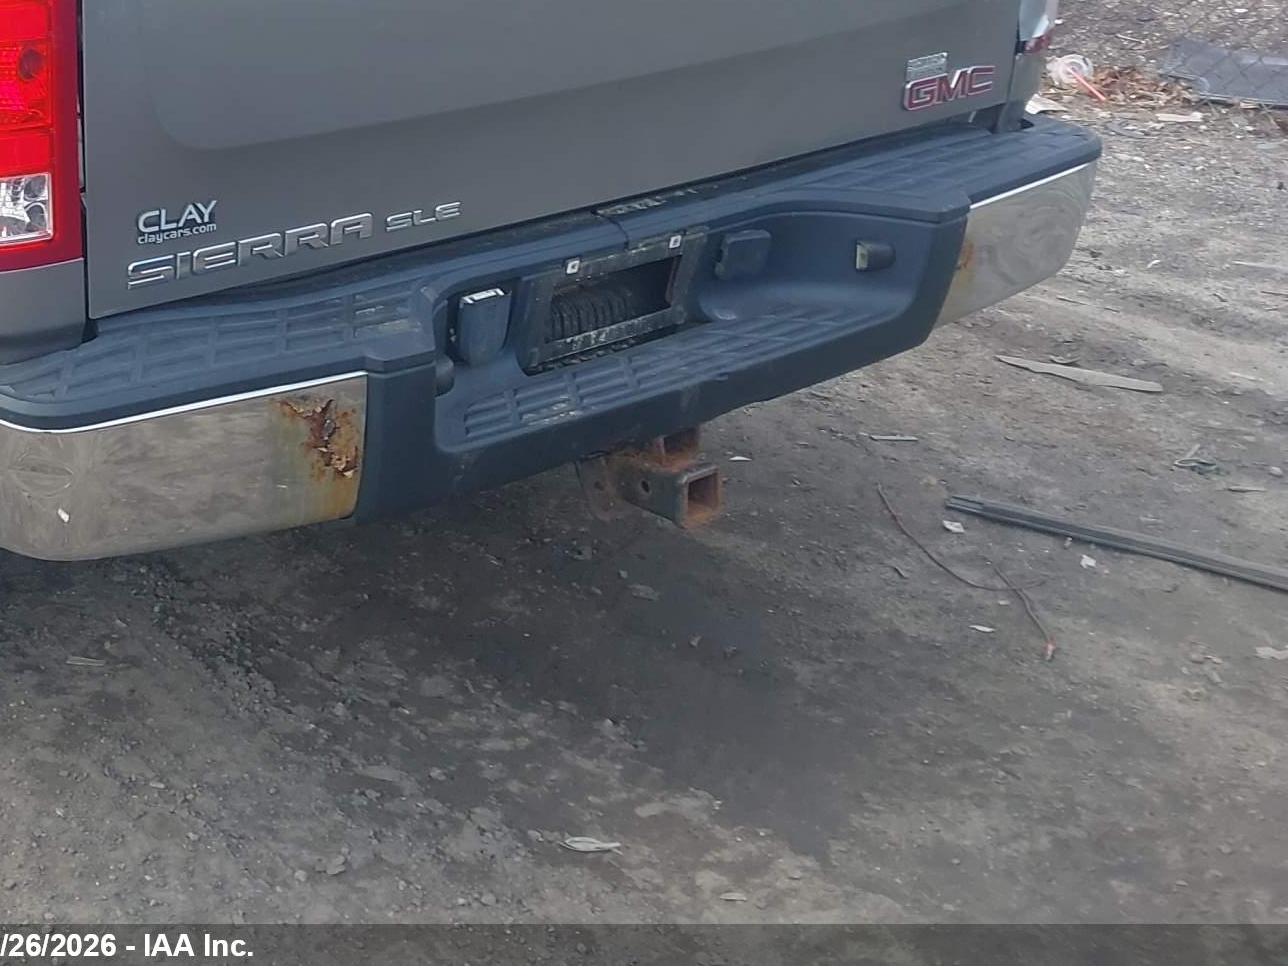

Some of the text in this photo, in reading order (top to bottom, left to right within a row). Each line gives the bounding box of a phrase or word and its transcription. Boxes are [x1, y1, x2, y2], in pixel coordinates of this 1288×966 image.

[904, 65, 995, 111] GMC
[137, 200, 217, 233] CLAY
[138, 222, 217, 244] claycars.com
[127, 201, 461, 290] SIERRA SLE
